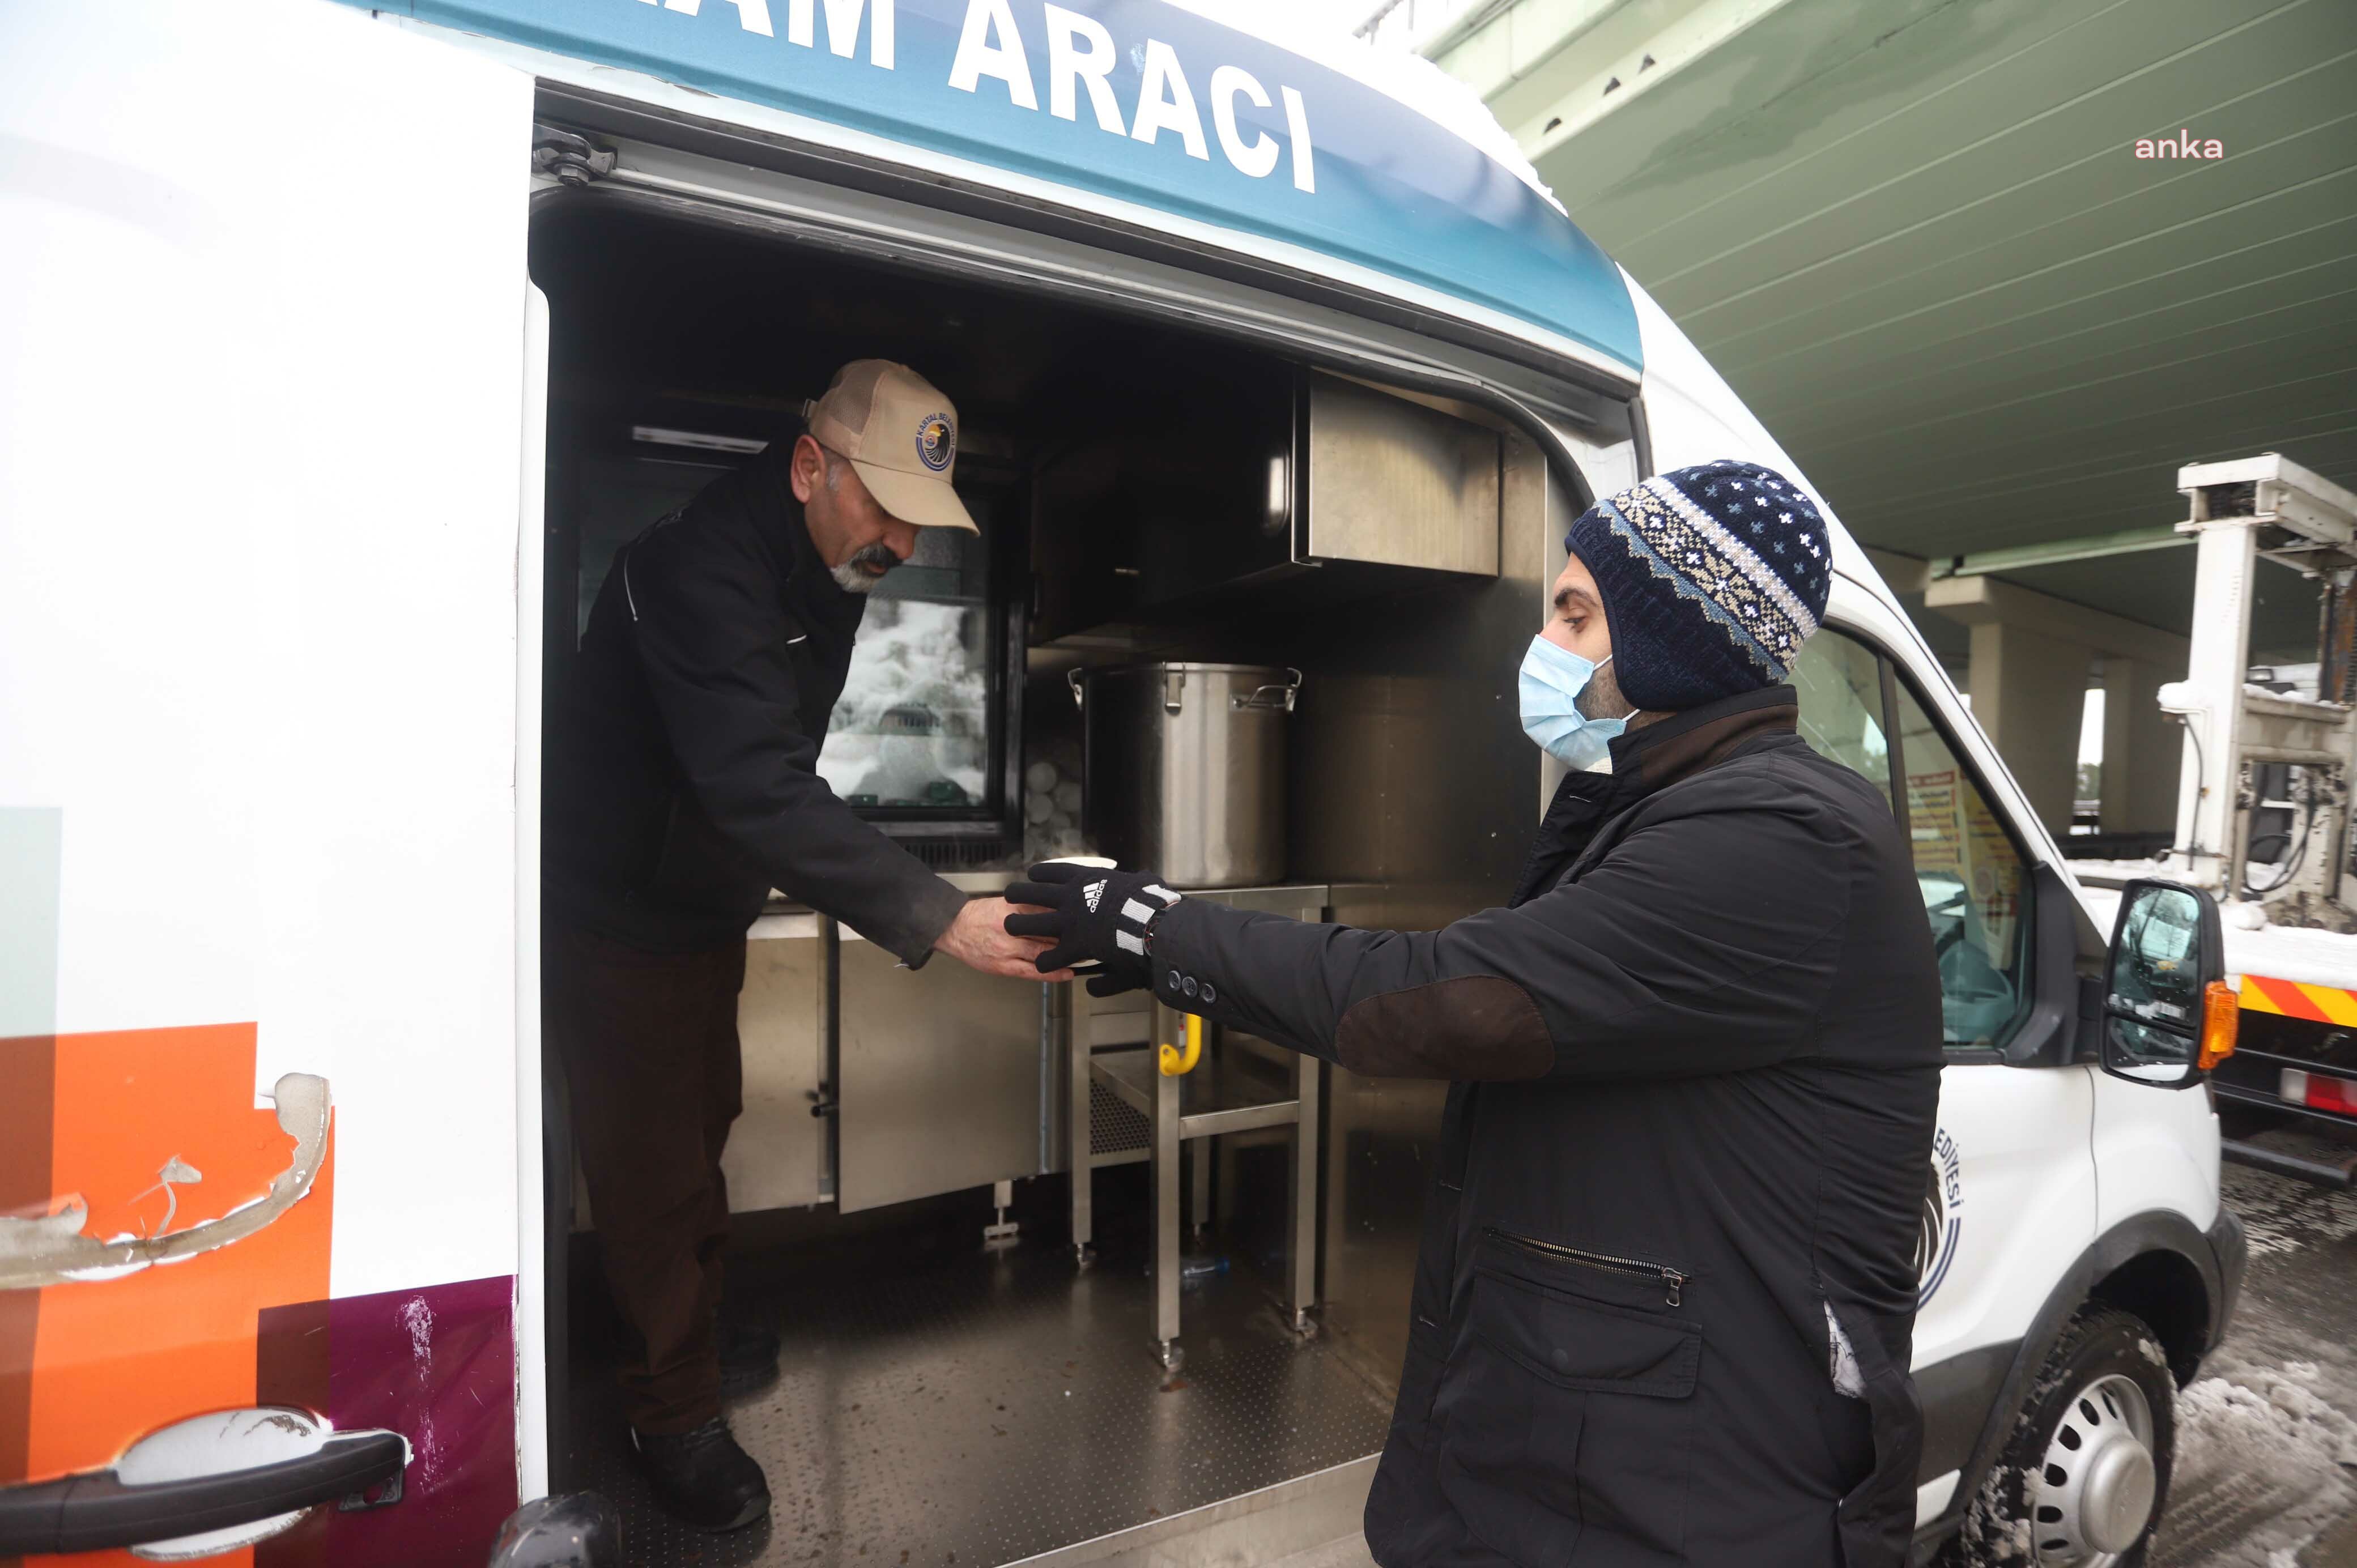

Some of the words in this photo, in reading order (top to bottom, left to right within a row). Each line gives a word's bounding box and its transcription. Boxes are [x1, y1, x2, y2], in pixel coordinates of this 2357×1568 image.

[947, 0, 1315, 194] ARACI
[916, 413, 938, 436] KARTAL
[1090, 879, 1108, 913] adidas
[1934, 1127, 1964, 1209] EDİYESİ
